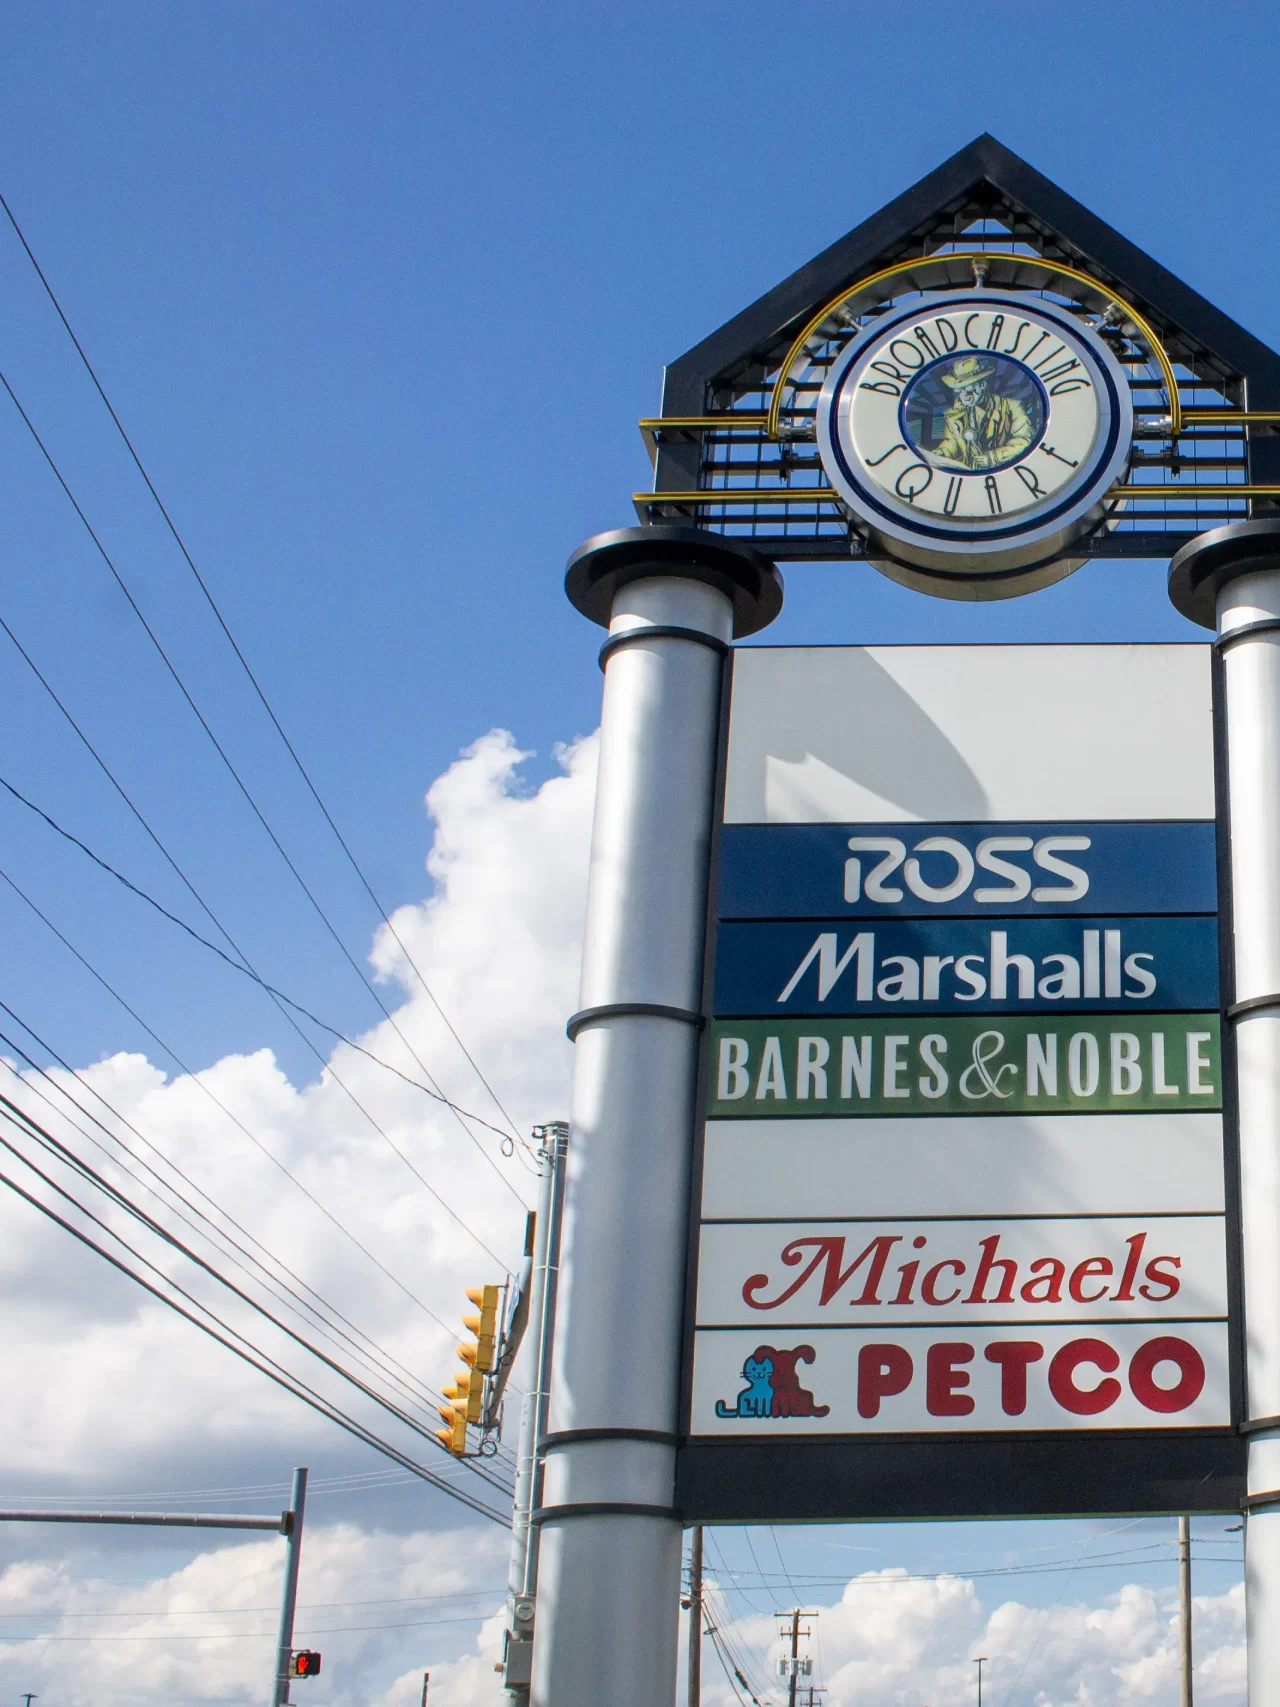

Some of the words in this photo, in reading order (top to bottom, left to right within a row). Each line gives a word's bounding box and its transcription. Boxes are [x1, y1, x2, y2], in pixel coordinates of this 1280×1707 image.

[859, 313, 1092, 397] BROADCASTING
[865, 442, 1079, 515] SQUARE
[844, 836, 1091, 903] ROSS
[776, 929, 1157, 1002] Marshalls
[717, 1034, 949, 1100] BARNES
[958, 1030, 1018, 1099] &
[1026, 1031, 1214, 1097] NOBLE
[742, 1232, 1182, 1310] Michaels
[857, 1336, 1206, 1419] PETCO
